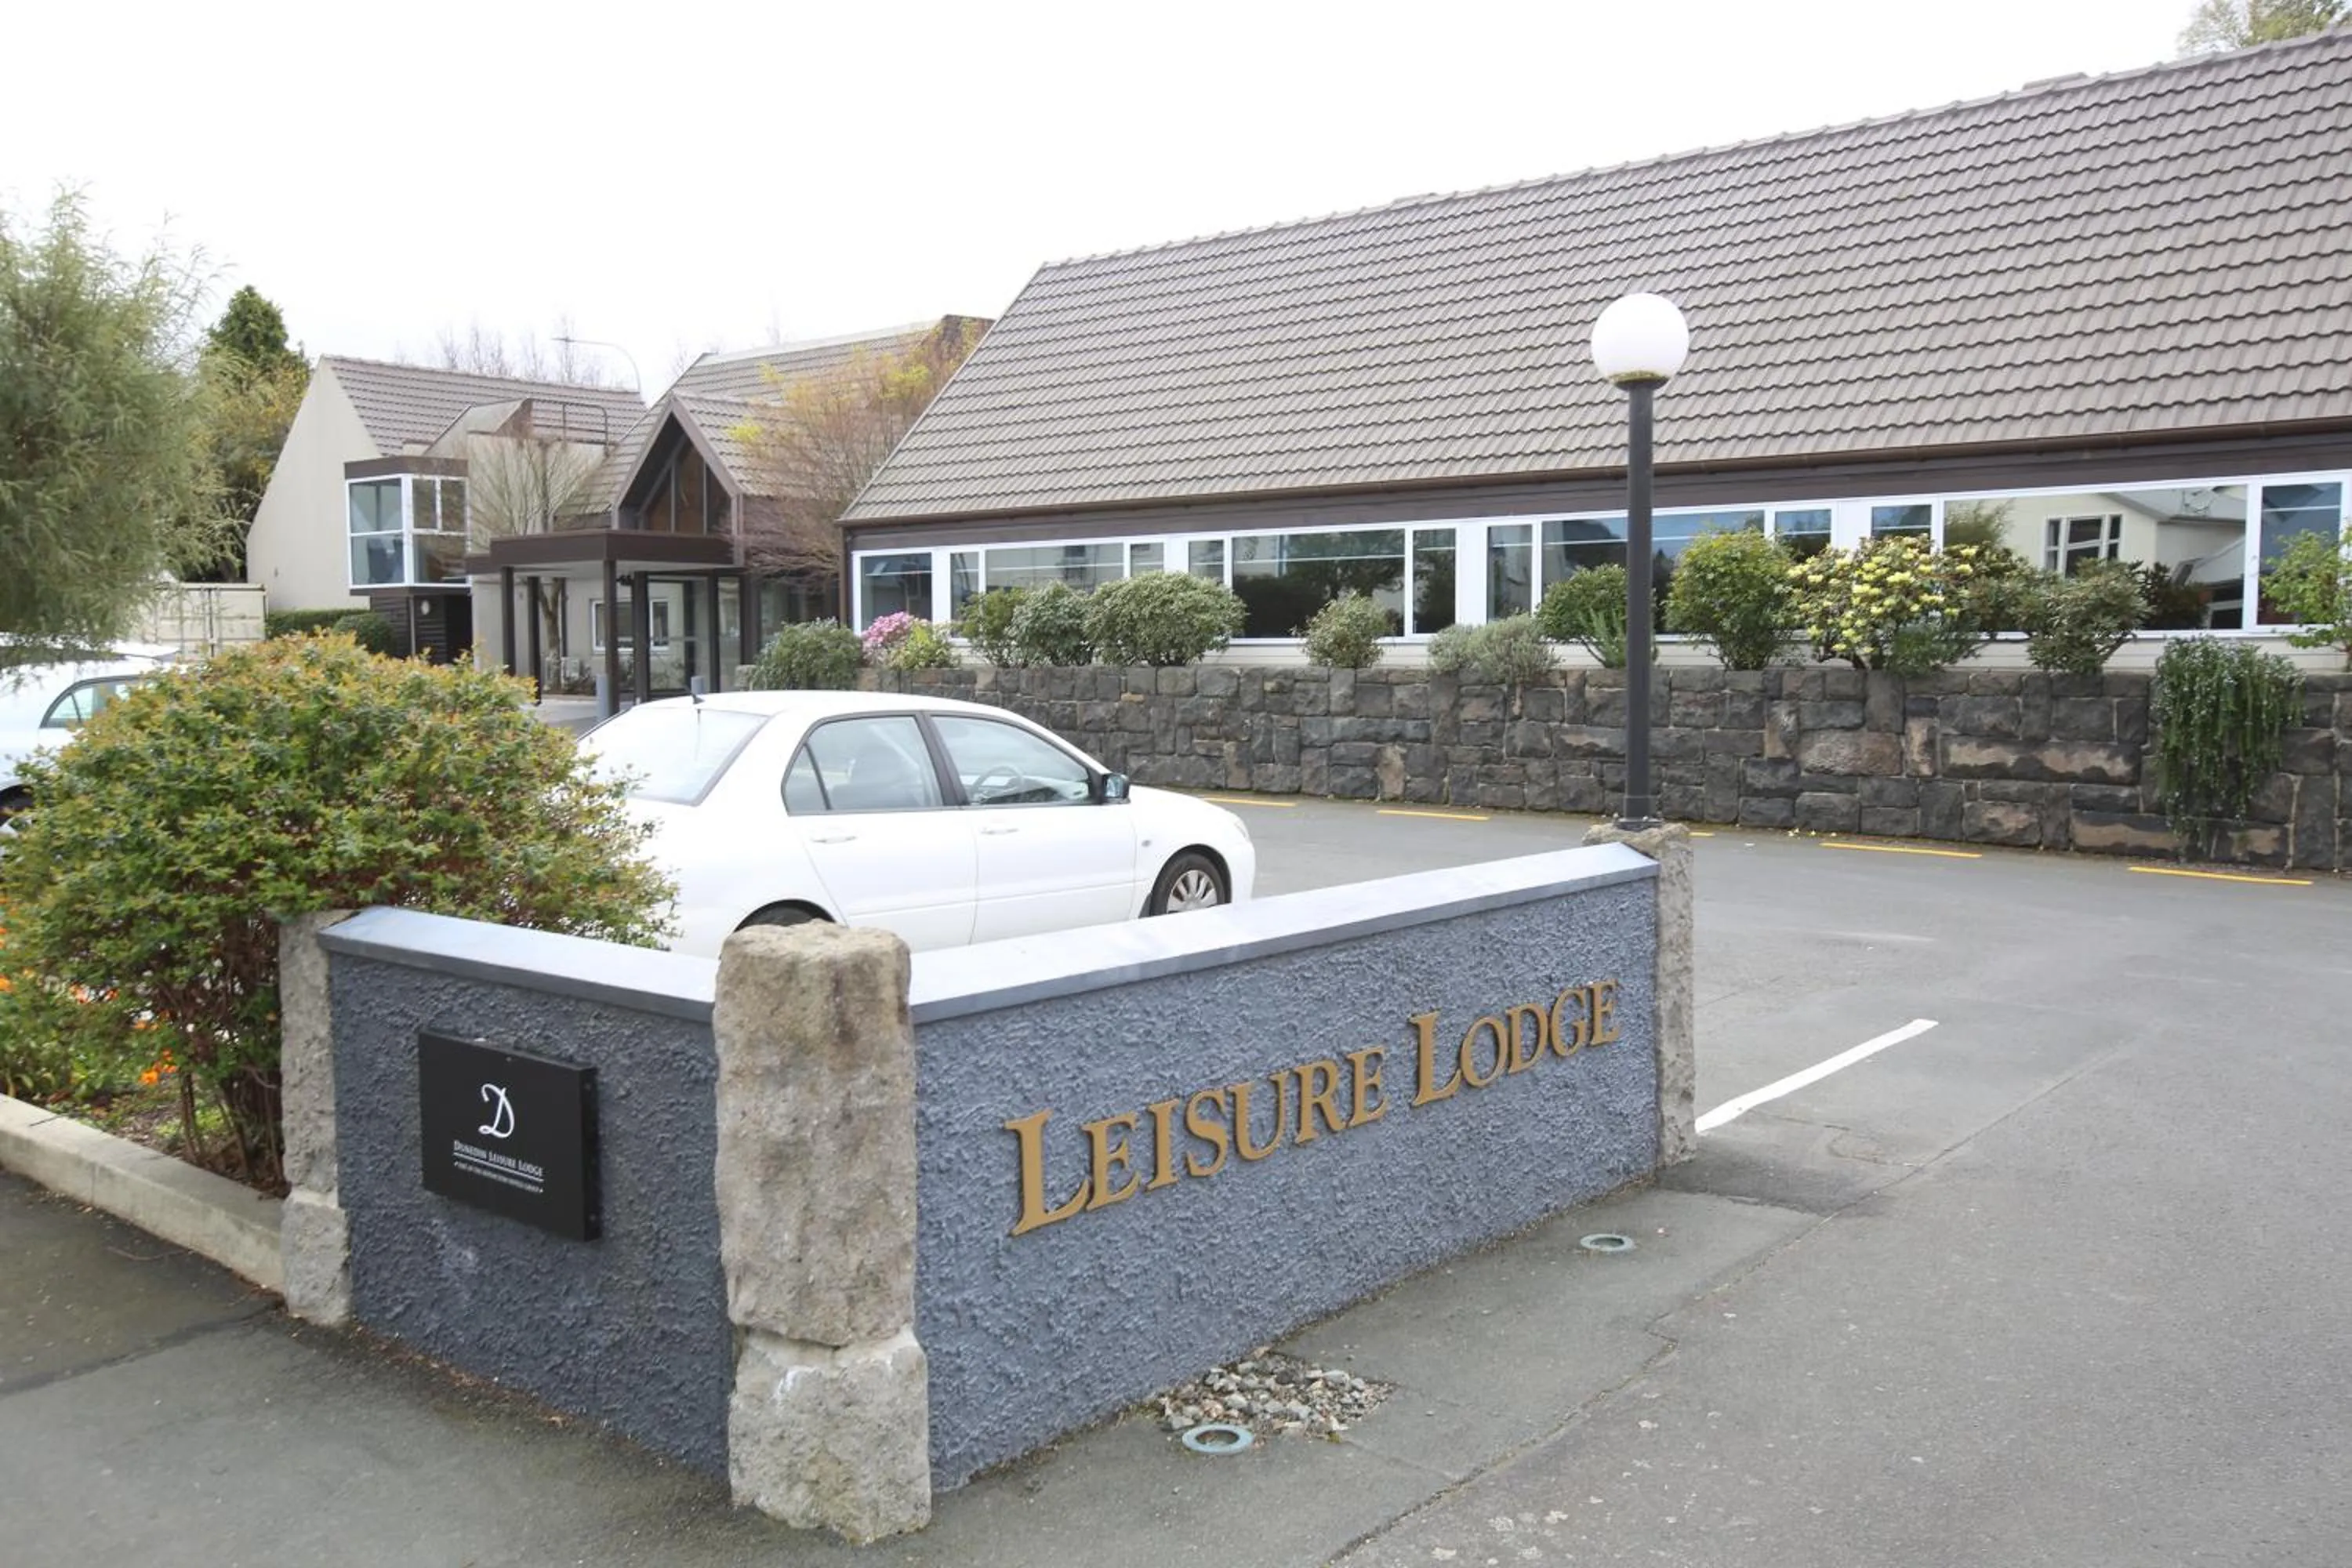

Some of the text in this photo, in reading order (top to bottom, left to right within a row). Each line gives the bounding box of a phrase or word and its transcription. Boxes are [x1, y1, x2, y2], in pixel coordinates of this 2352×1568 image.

[518, 1160, 543, 1178] LODGE
[1005, 978, 1620, 1236] LEISURE LODGE
